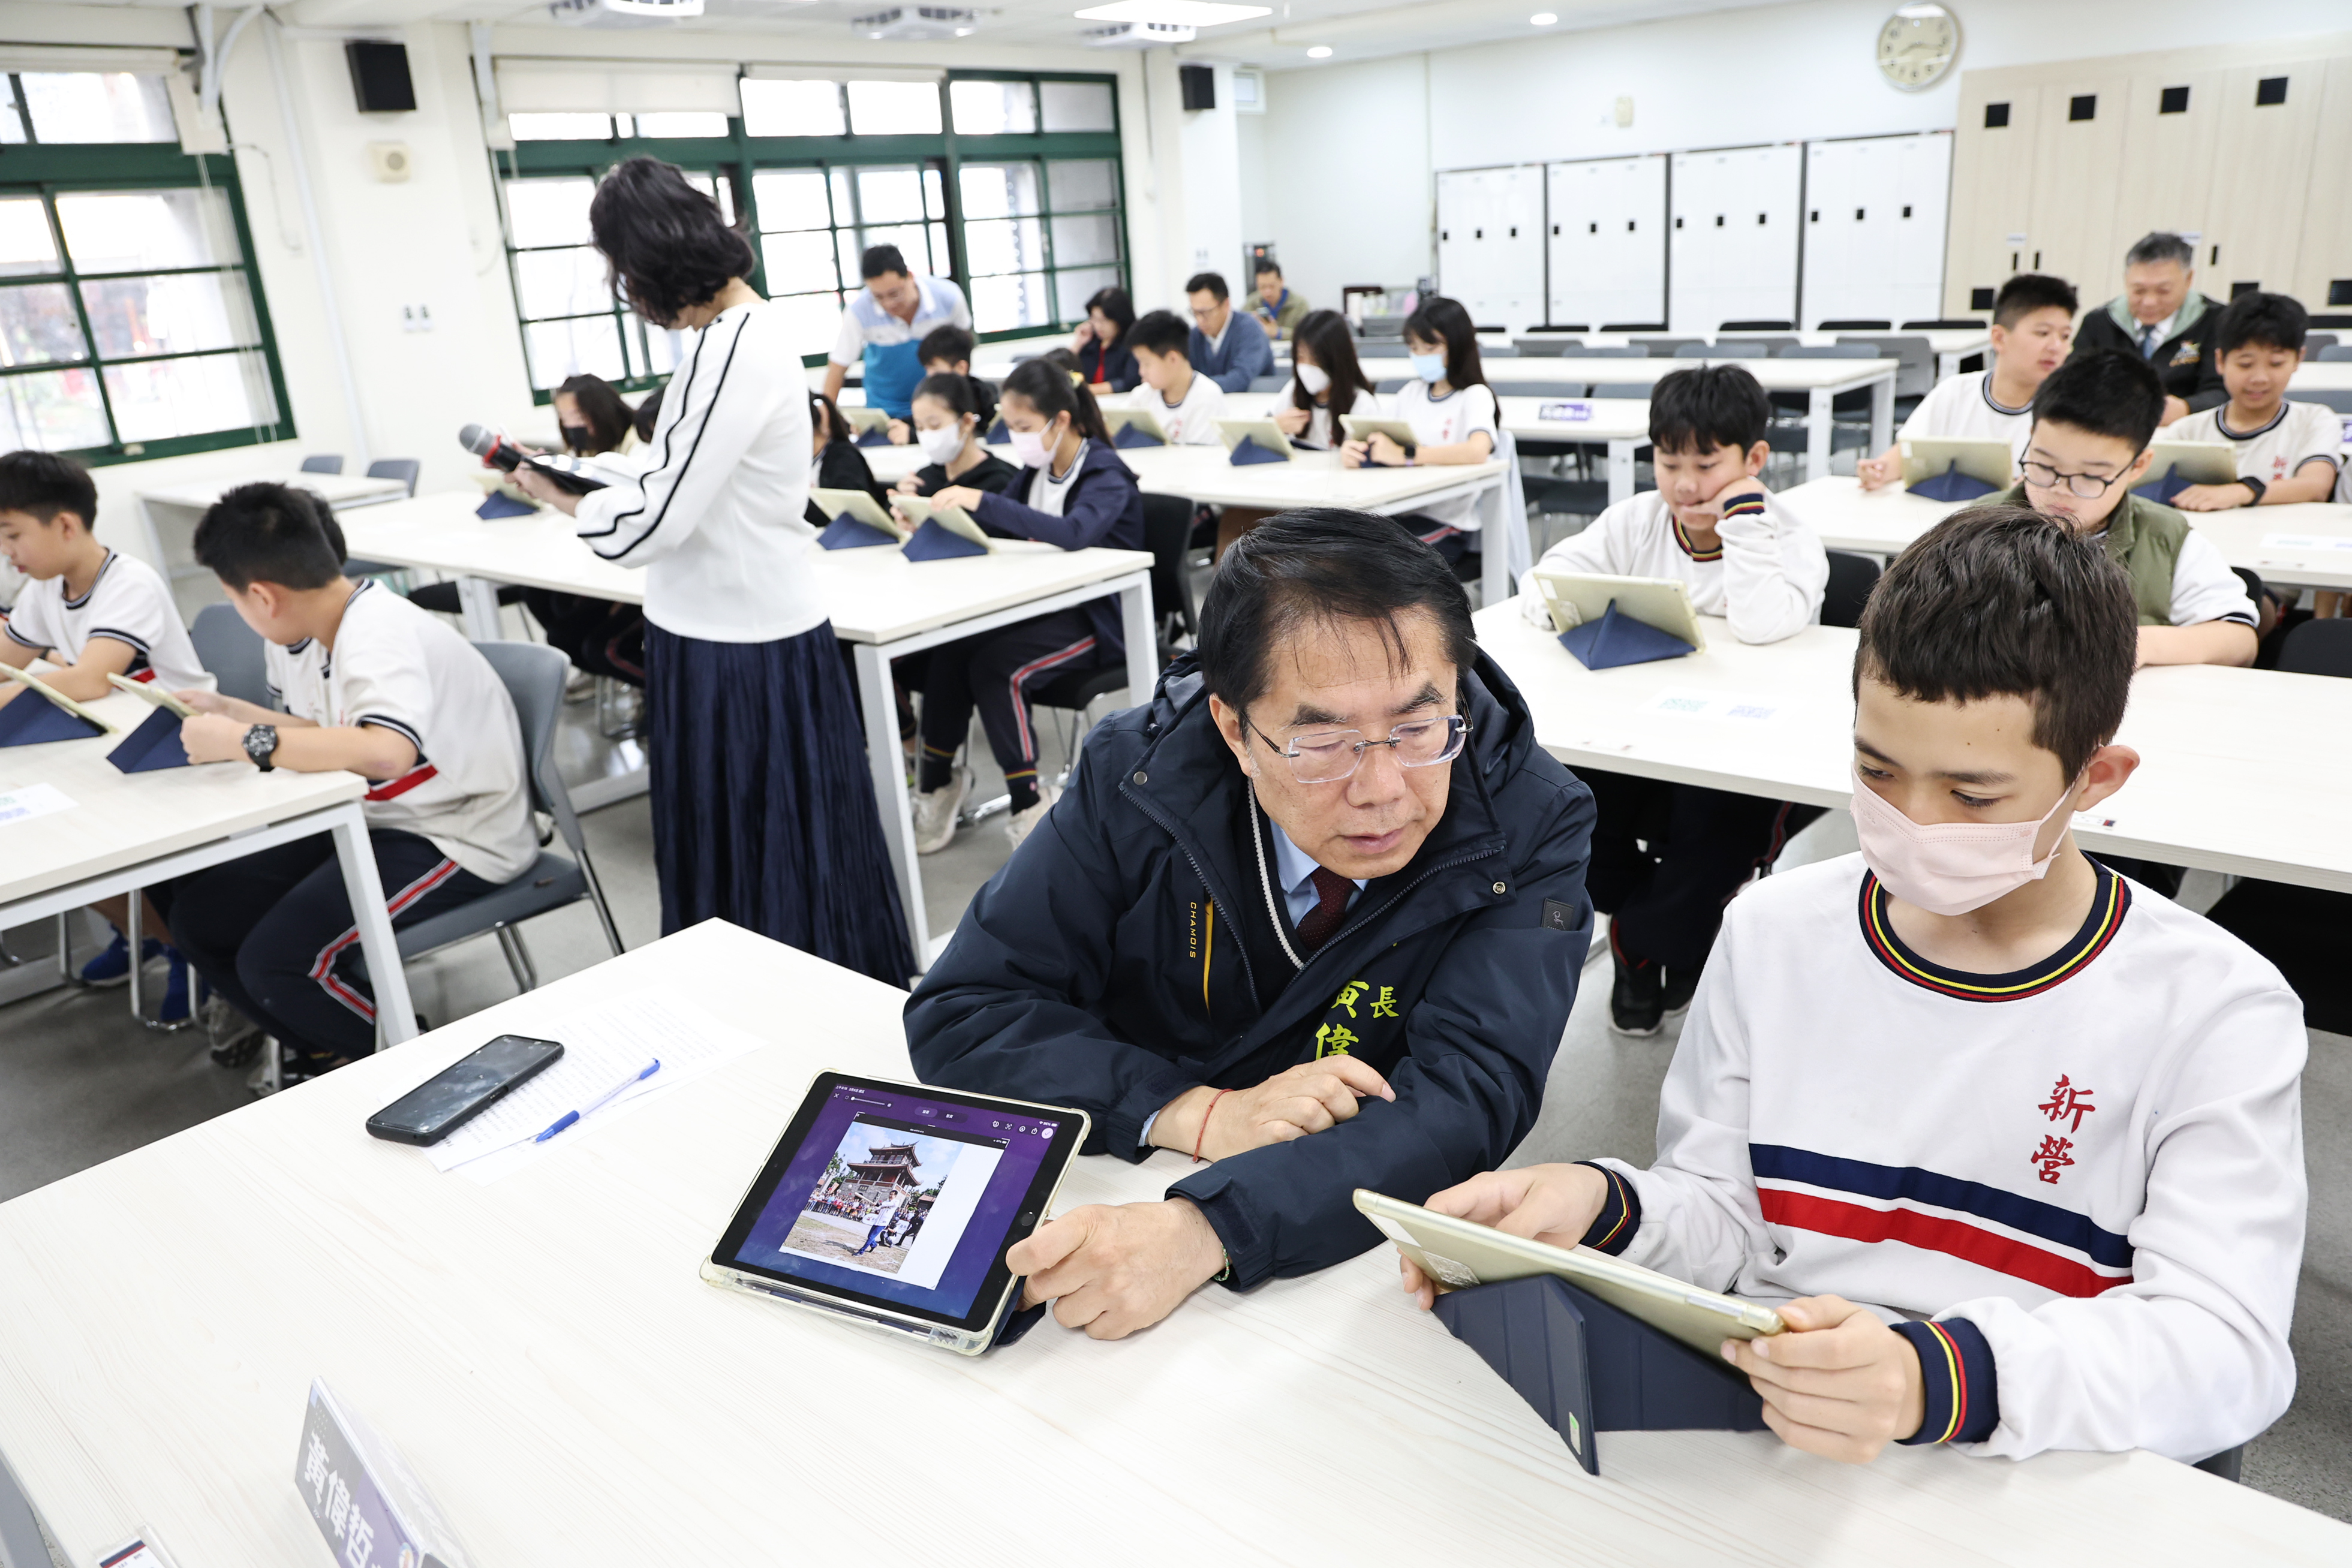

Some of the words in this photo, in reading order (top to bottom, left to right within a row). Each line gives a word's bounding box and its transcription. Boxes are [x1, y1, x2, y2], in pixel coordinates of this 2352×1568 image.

[1370, 985, 1400, 1019] 長
[2031, 1073, 2096, 1185] 新營
[305, 1434, 374, 1568] 黃偉哲
